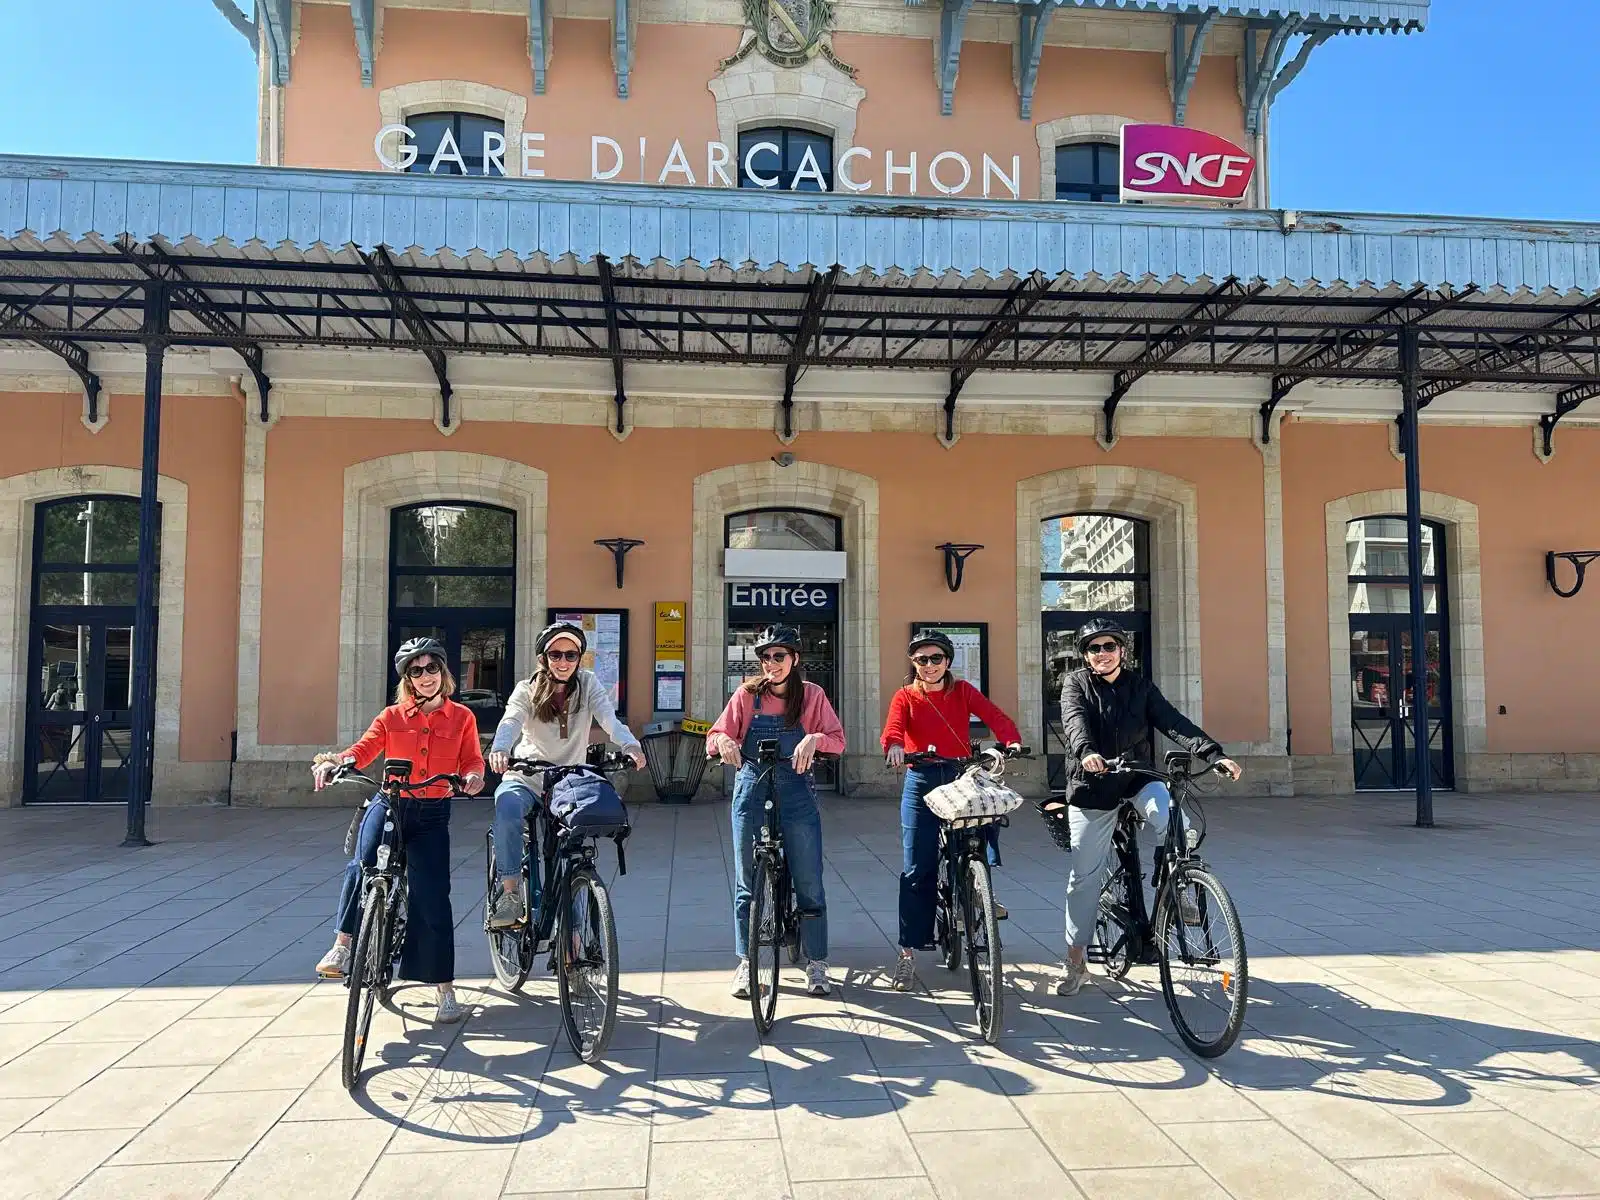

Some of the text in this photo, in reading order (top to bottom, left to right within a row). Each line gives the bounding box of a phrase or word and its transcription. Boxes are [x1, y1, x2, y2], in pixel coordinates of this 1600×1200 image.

[375, 124, 1020, 199] GARE D'ARCACHON
[1129, 152, 1250, 188] SNCF
[732, 583, 828, 607] Entrée
